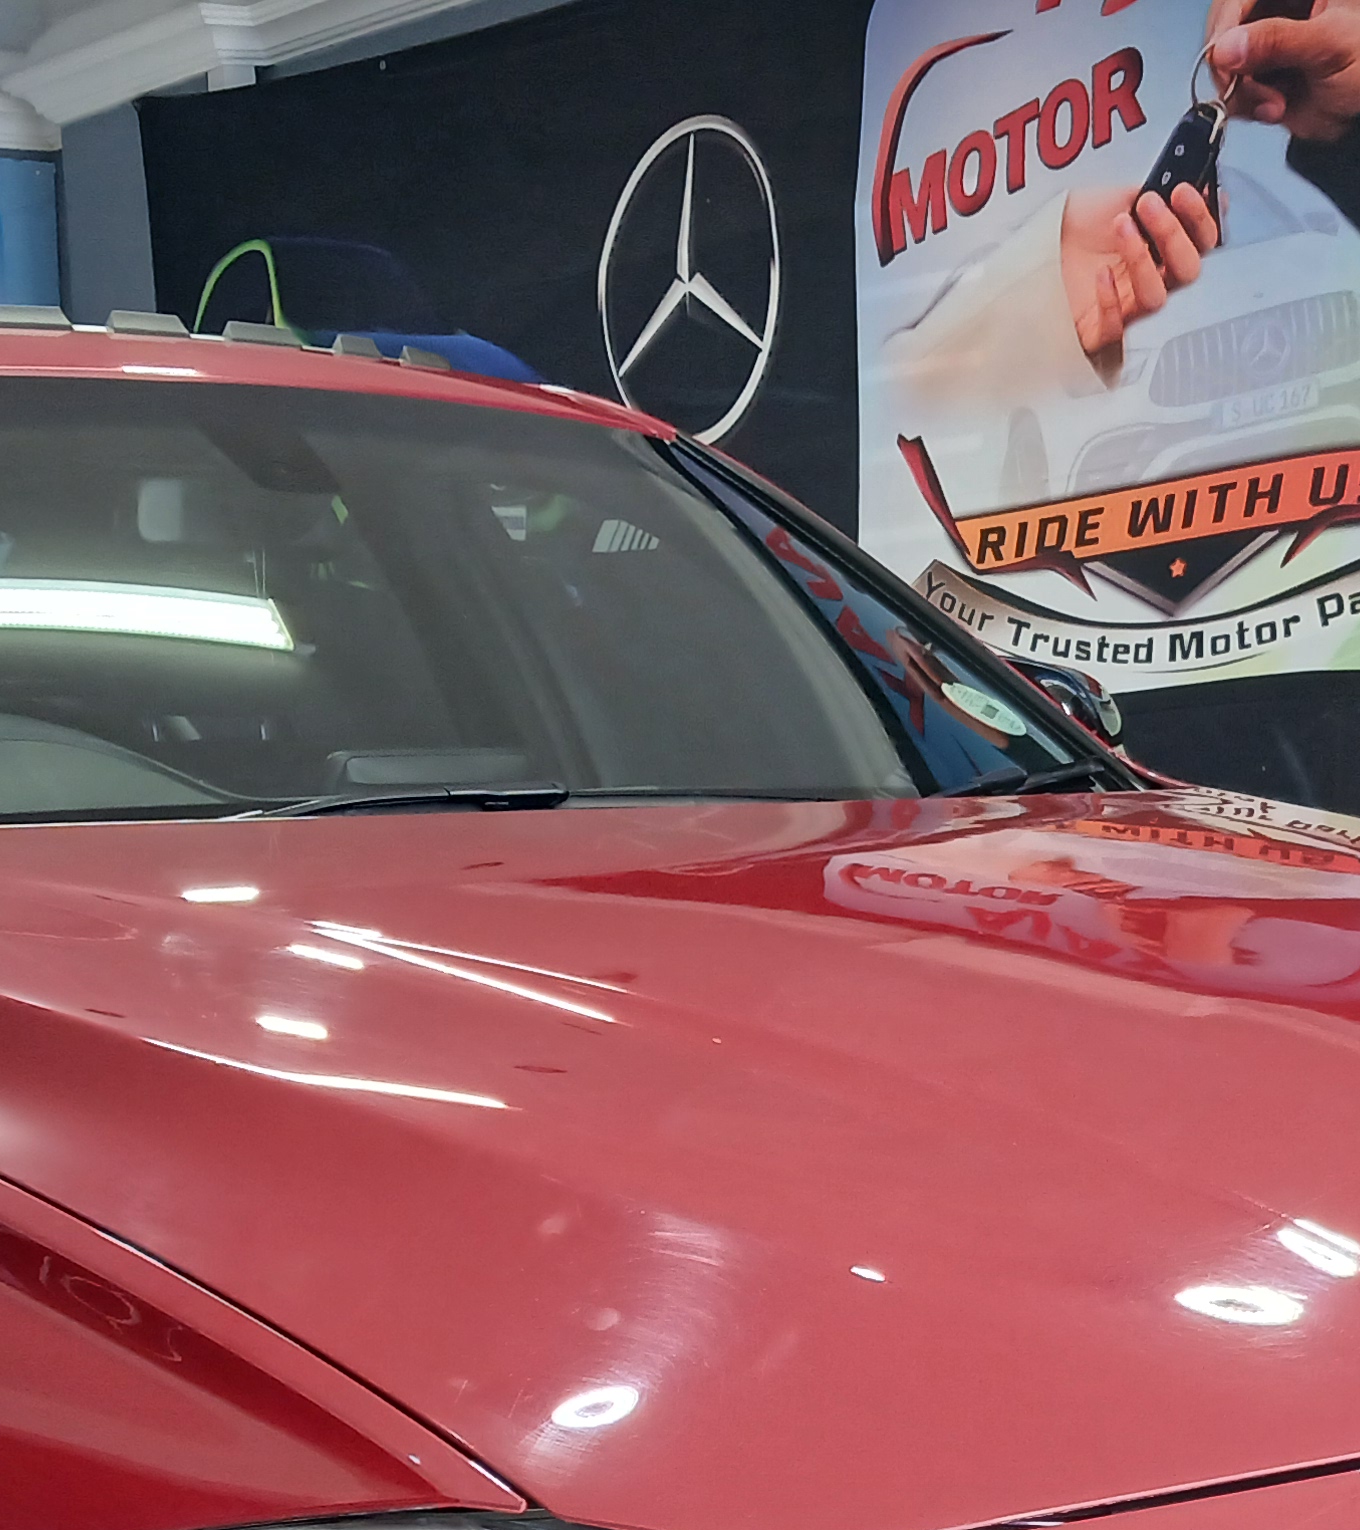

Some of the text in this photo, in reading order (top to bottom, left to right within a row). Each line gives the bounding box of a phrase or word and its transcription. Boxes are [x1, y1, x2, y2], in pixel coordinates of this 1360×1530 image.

[888, 46, 1147, 256] MOTOR
[977, 505, 1106, 566] RIDE
[1127, 470, 1285, 540] WITH
[919, 569, 997, 633] Your
[1006, 615, 1155, 666] Trusted
[1167, 610, 1303, 663] Motor
